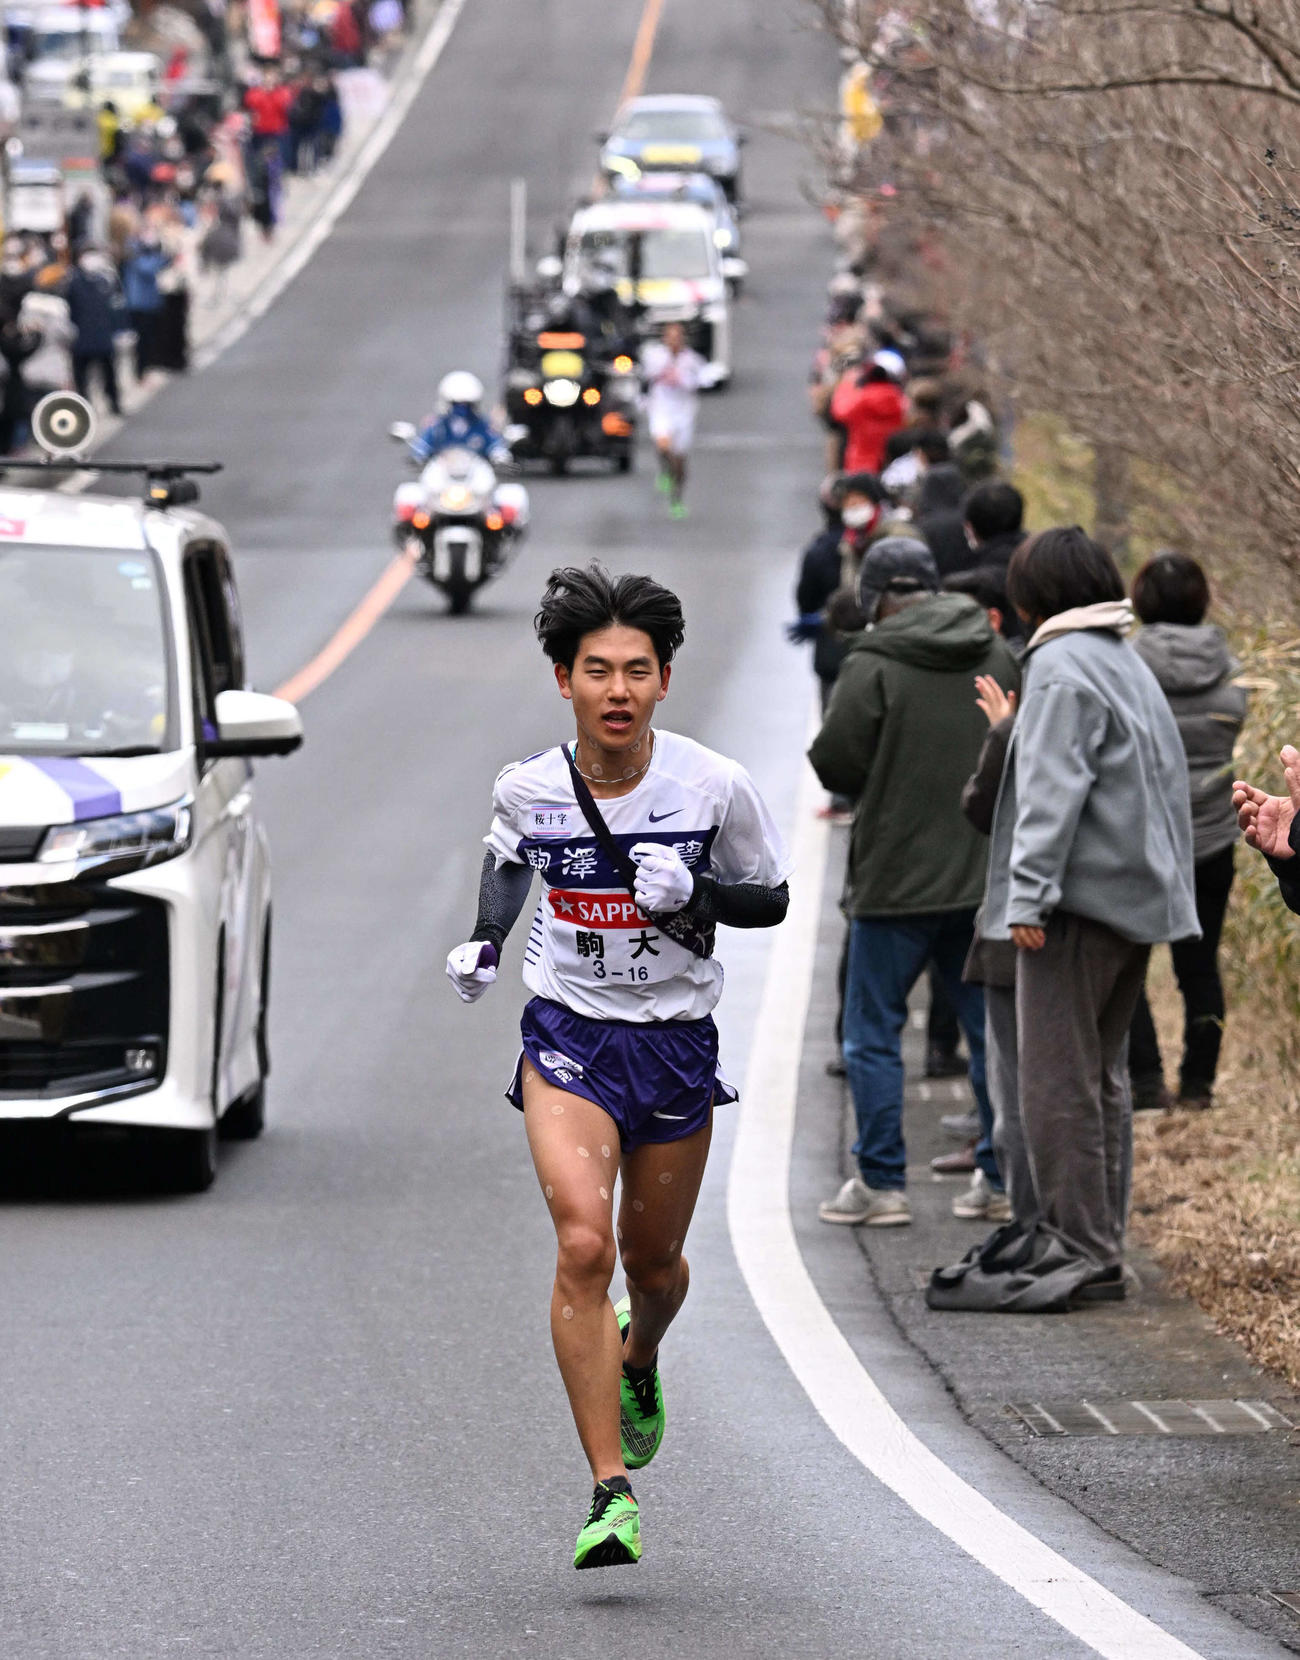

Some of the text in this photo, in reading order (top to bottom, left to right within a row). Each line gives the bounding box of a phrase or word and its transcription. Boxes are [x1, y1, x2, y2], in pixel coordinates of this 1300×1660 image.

[535, 813, 567, 825] 桜十字
[524, 840, 703, 880] 駒澤學
[593, 960, 649, 982] 3-16
